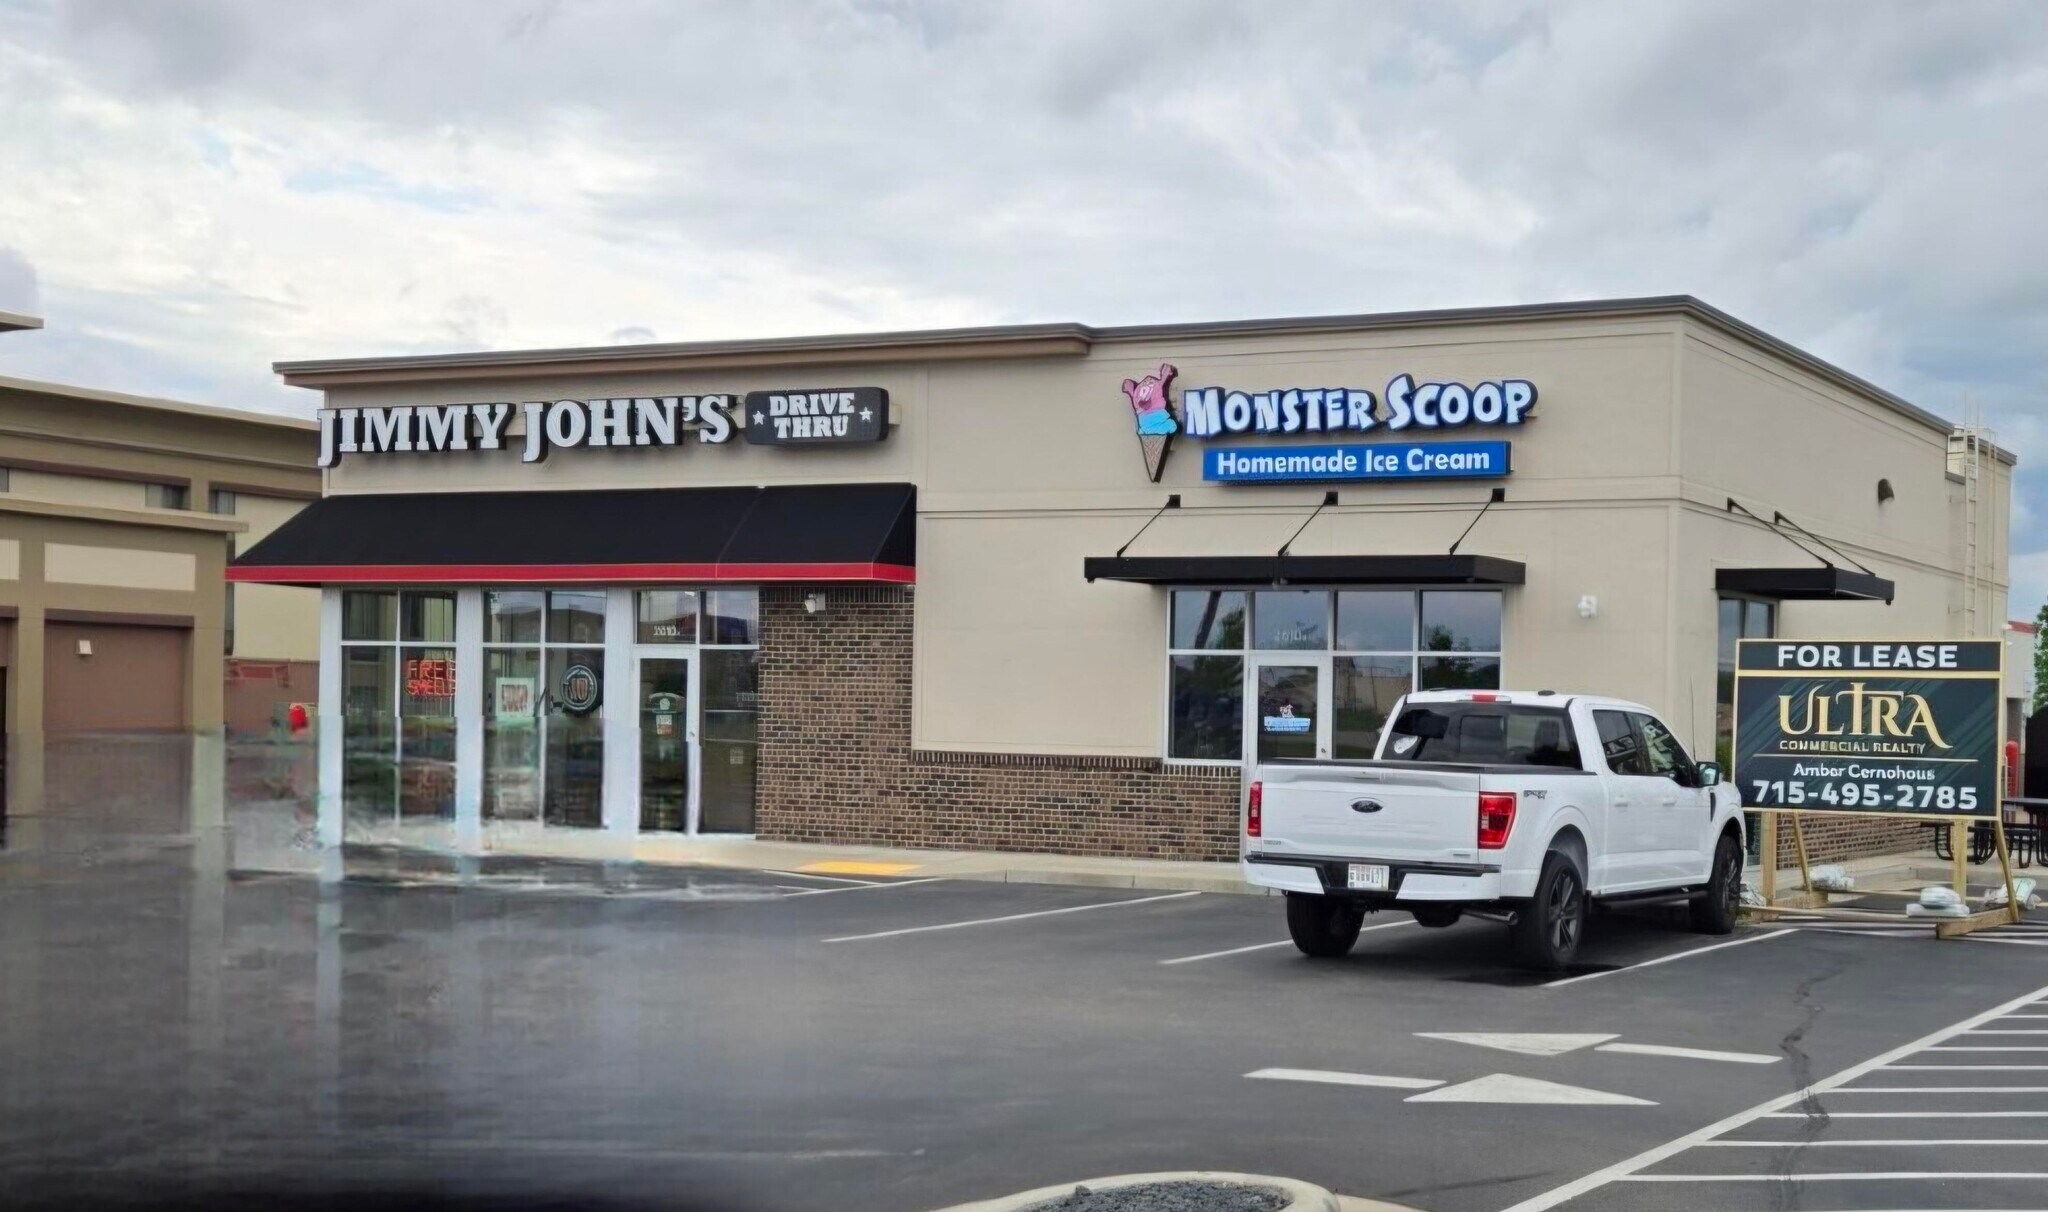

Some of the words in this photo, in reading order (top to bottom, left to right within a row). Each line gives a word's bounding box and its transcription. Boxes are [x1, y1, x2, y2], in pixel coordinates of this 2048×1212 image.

[769, 392, 855, 416] DRIVE
[317, 403, 511, 466] JIMMY
[522, 394, 734, 462] JOHN'S
[774, 415, 849, 438] THRU
[1217, 450, 1358, 475] Homemade
[1366, 449, 1399, 472] Ice
[1403, 447, 1490, 472] Cream
[1777, 645, 1842, 667] FOR
[1853, 645, 1958, 668] LEASE
[1778, 682, 1953, 749] ULTRA
[1779, 740, 1869, 752] COMMERCIAL
[1873, 742, 1926, 754] REALTY
[1752, 780, 1978, 810] 715-495-2785
